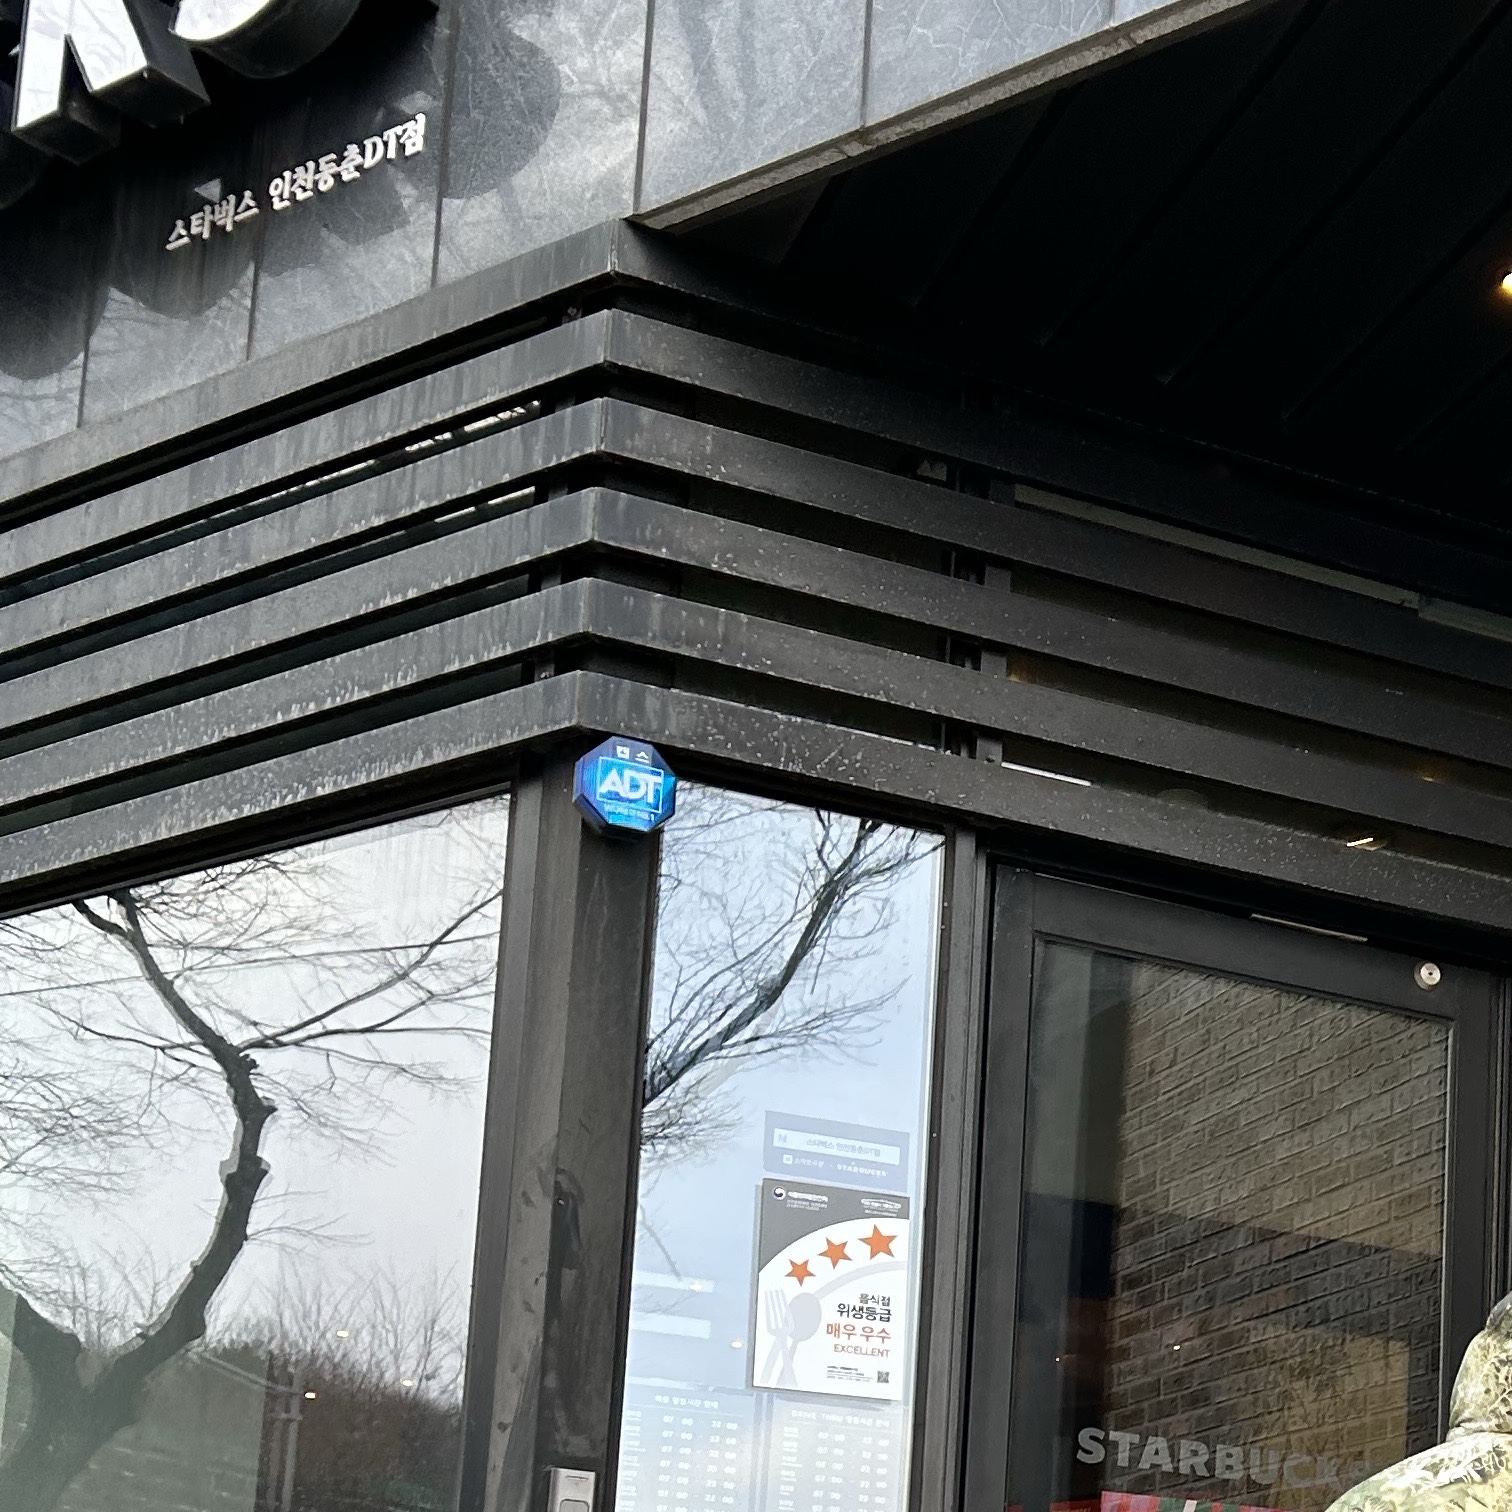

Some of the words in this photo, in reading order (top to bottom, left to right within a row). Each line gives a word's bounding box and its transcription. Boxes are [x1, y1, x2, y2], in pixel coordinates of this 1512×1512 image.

[165, 190, 260, 250] 스타벅스
[268, 112, 427, 211] 인천동춘DT점
[600, 768, 662, 803] ADT
[837, 1303, 891, 1322] 위생등급
[826, 1323, 857, 1340] 매우
[860, 1326, 891, 1344] 우수
[834, 1344, 890, 1358] EXCELLENT
